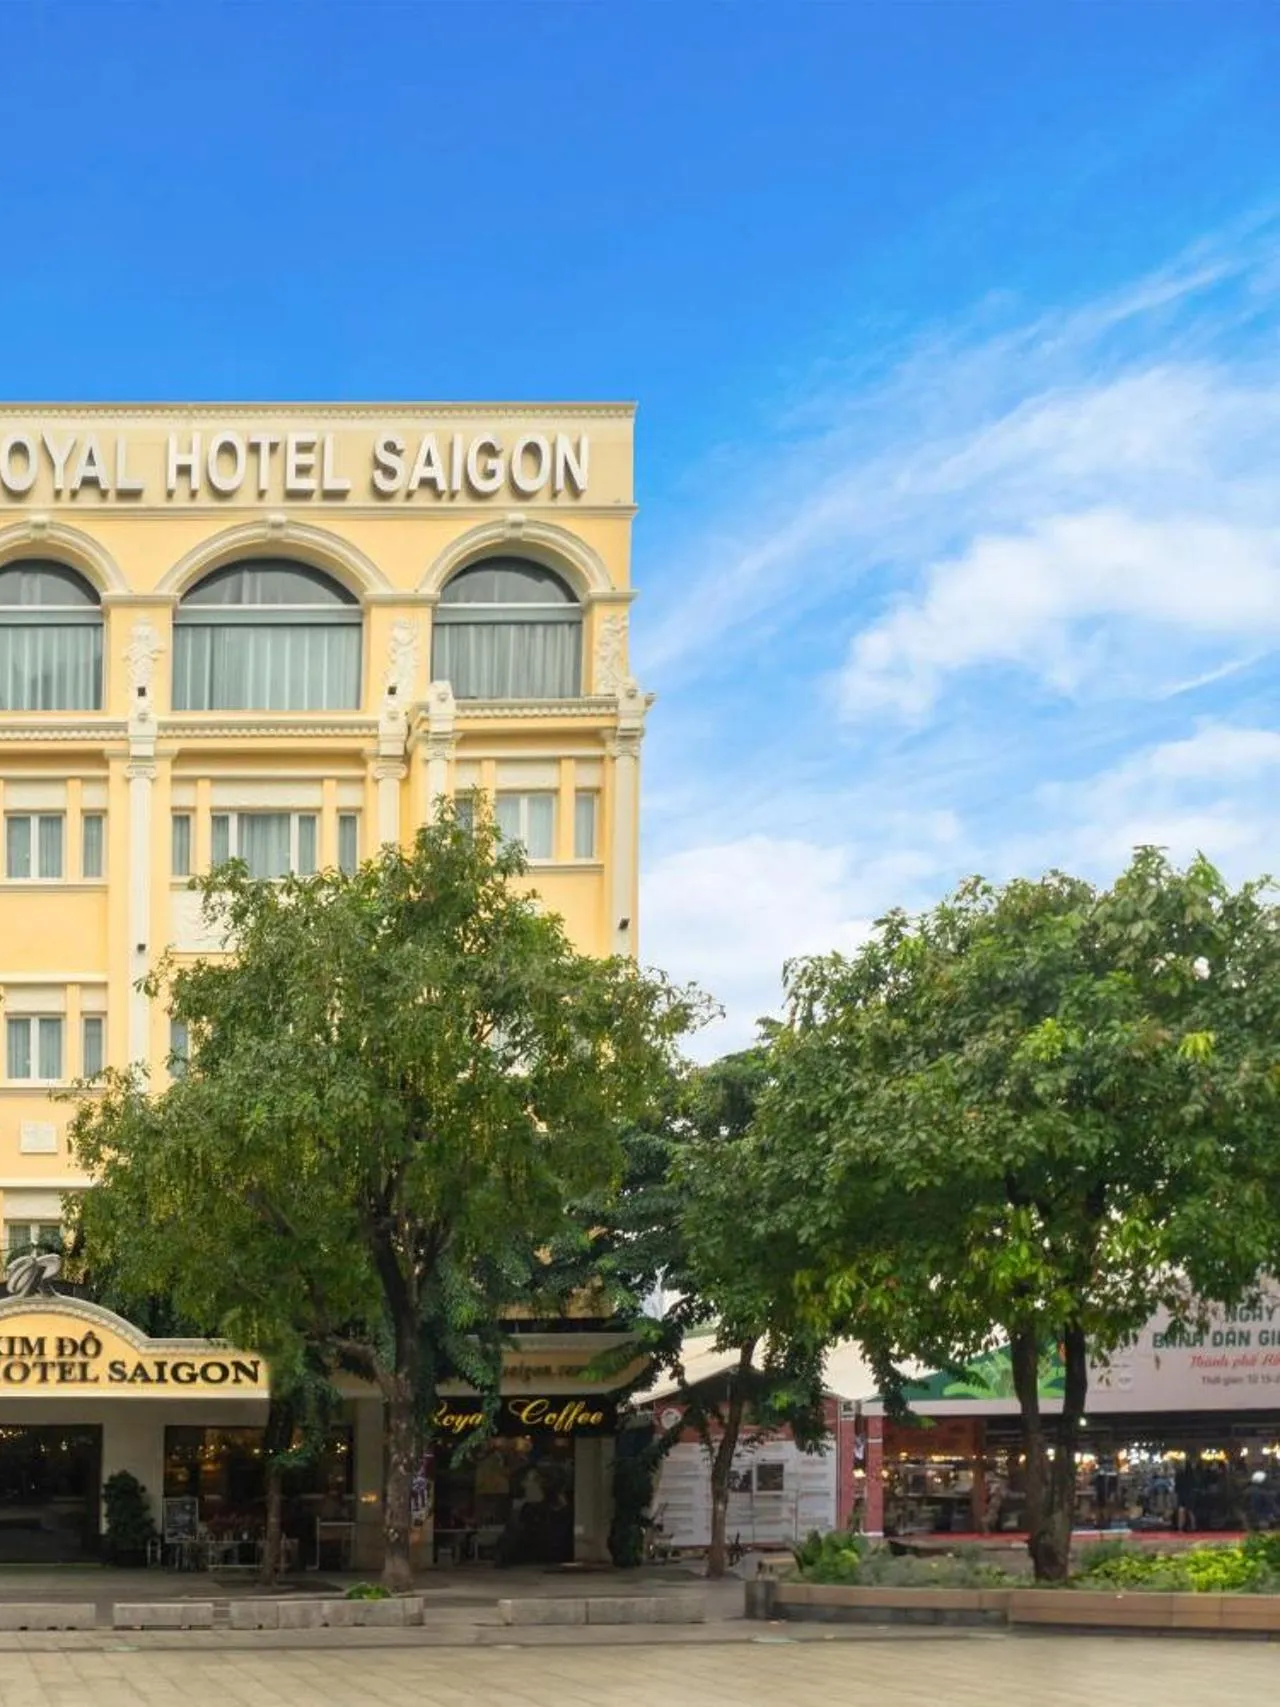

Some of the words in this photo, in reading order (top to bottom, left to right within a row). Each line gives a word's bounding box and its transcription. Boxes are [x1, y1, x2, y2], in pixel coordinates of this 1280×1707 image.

[166, 432, 351, 498] HOTEL
[371, 431, 590, 498] SAIGON
[55, 1330, 103, 1359] ĐÔ
[1258, 1329, 1280, 1347] GI
[108, 1358, 260, 1385] SAIGON
[433, 1399, 485, 1435] Roya
[508, 1399, 604, 1433] Coffee
